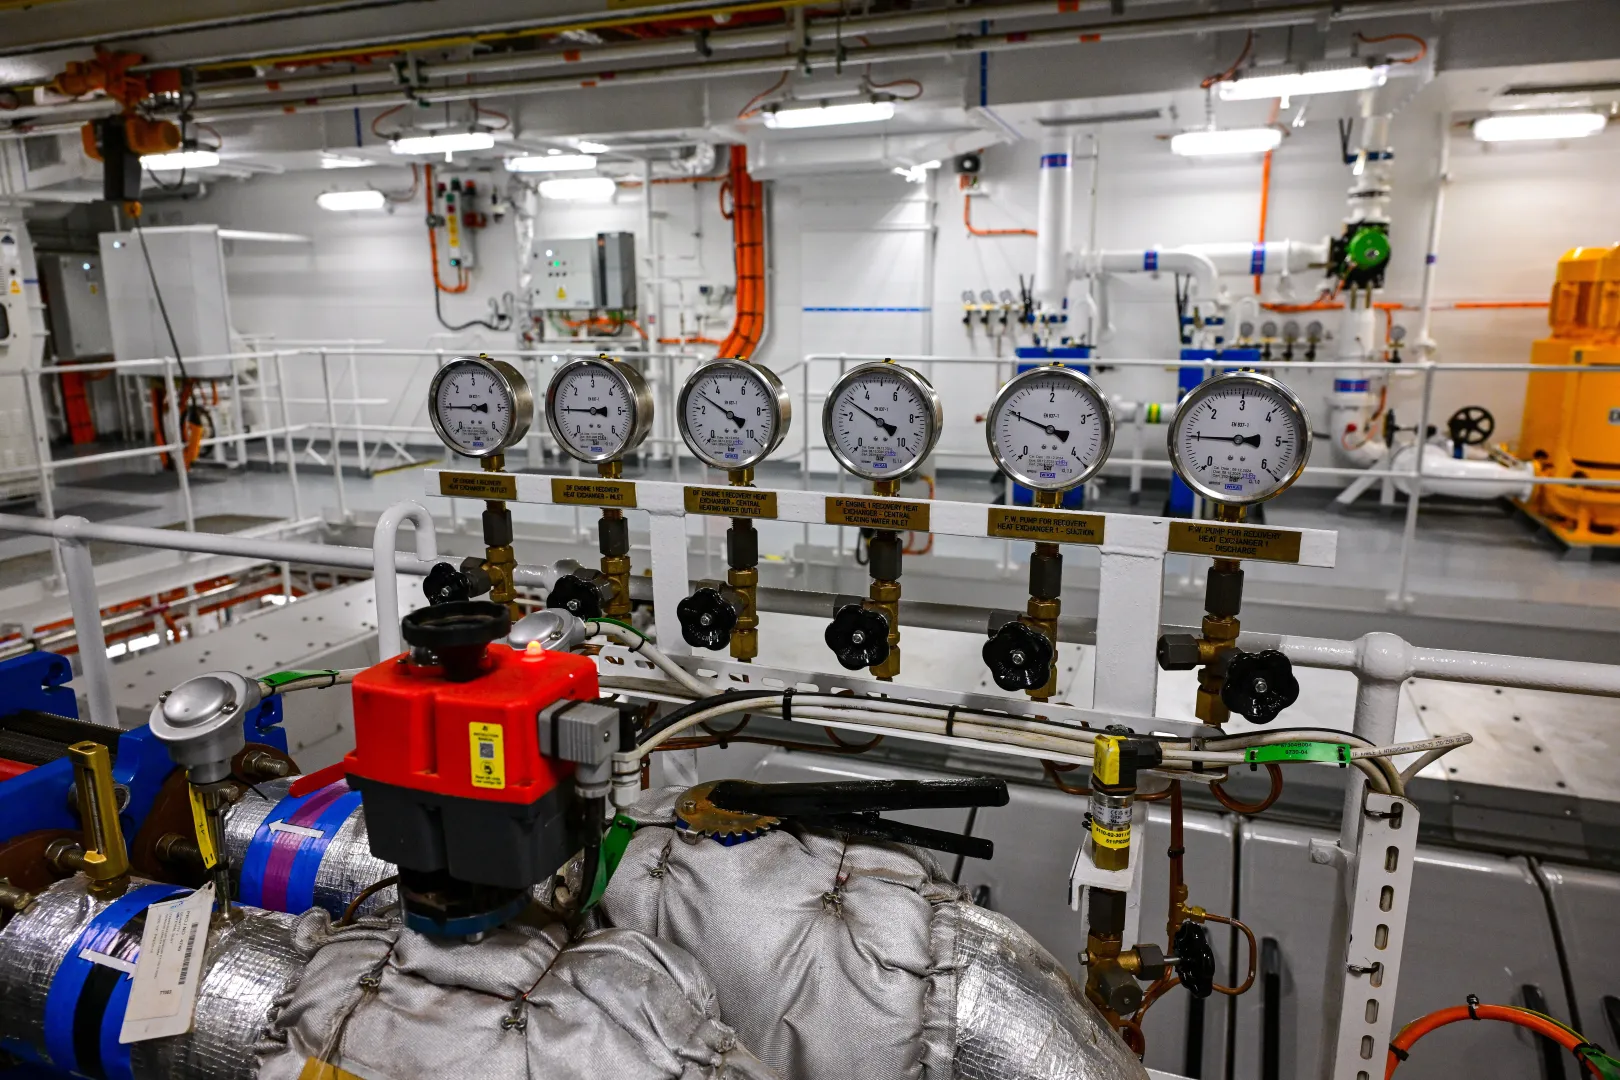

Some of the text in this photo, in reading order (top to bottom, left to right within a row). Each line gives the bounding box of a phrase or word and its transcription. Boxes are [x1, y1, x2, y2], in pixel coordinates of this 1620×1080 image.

[471, 378, 475, 386] 3
[591, 379, 595, 388] 3
[456, 385, 459, 394] 2
[488, 386, 493, 394] 4
[574, 387, 578, 396] 2
[609, 388, 613, 396] 4
[716, 386, 720, 394] 4
[741, 386, 746, 395] 6
[865, 391, 870, 400] 4
[893, 392, 898, 401] 6
[1050, 392, 1055, 403] 2
[497, 404, 501, 412] 5
[617, 406, 622, 415] 5
[701, 405, 706, 415] 2
[1239, 400, 1245, 411] 3
[756, 407, 761, 416] 8
[1211, 408, 1217, 420] 2
[849, 412, 854, 422] 2
[909, 414, 914, 424] 8
[1017, 412, 1021, 422] 1
[1081, 414, 1086, 425] 3
[1266, 412, 1272, 423] 4
[459, 422, 463, 430] 0
[576, 425, 580, 433] 0
[611, 425, 615, 434] 6
[710, 430, 715, 438] 0
[746, 429, 754, 439] 10
[1196, 431, 1200, 442] 1
[858, 437, 862, 447] 0
[897, 437, 906, 447] 10
[1275, 436, 1282, 447] 5
[1023, 445, 1029, 455] 0
[1071, 446, 1076, 456] 4
[1207, 456, 1213, 467] 0
[1261, 459, 1267, 470] 6
[726, 491, 752, 499] RECOVERY
[700, 497, 731, 505] EXCHANGER
[845, 501, 866, 509] ENGINE
[872, 503, 902, 511] RECOVERY
[699, 504, 720, 512] HEATING
[741, 507, 761, 515] OUTLET
[843, 508, 877, 516] EXCHANGER
[845, 516, 869, 524] HEATING
[892, 519, 908, 527] INLET
[1004, 515, 1018, 523] F.W.
[1020, 516, 1037, 524] PUMP
[1053, 519, 1087, 528] RECOVERY
[1016, 524, 1054, 533] EXCHANGER
[1188, 525, 1282, 539] F.W. PUMP FOR RECOVERY
[1199, 535, 1216, 543] HEAT
[1220, 537, 1263, 547] EXCHANGER
[1215, 545, 1257, 555] DISCHARGE
